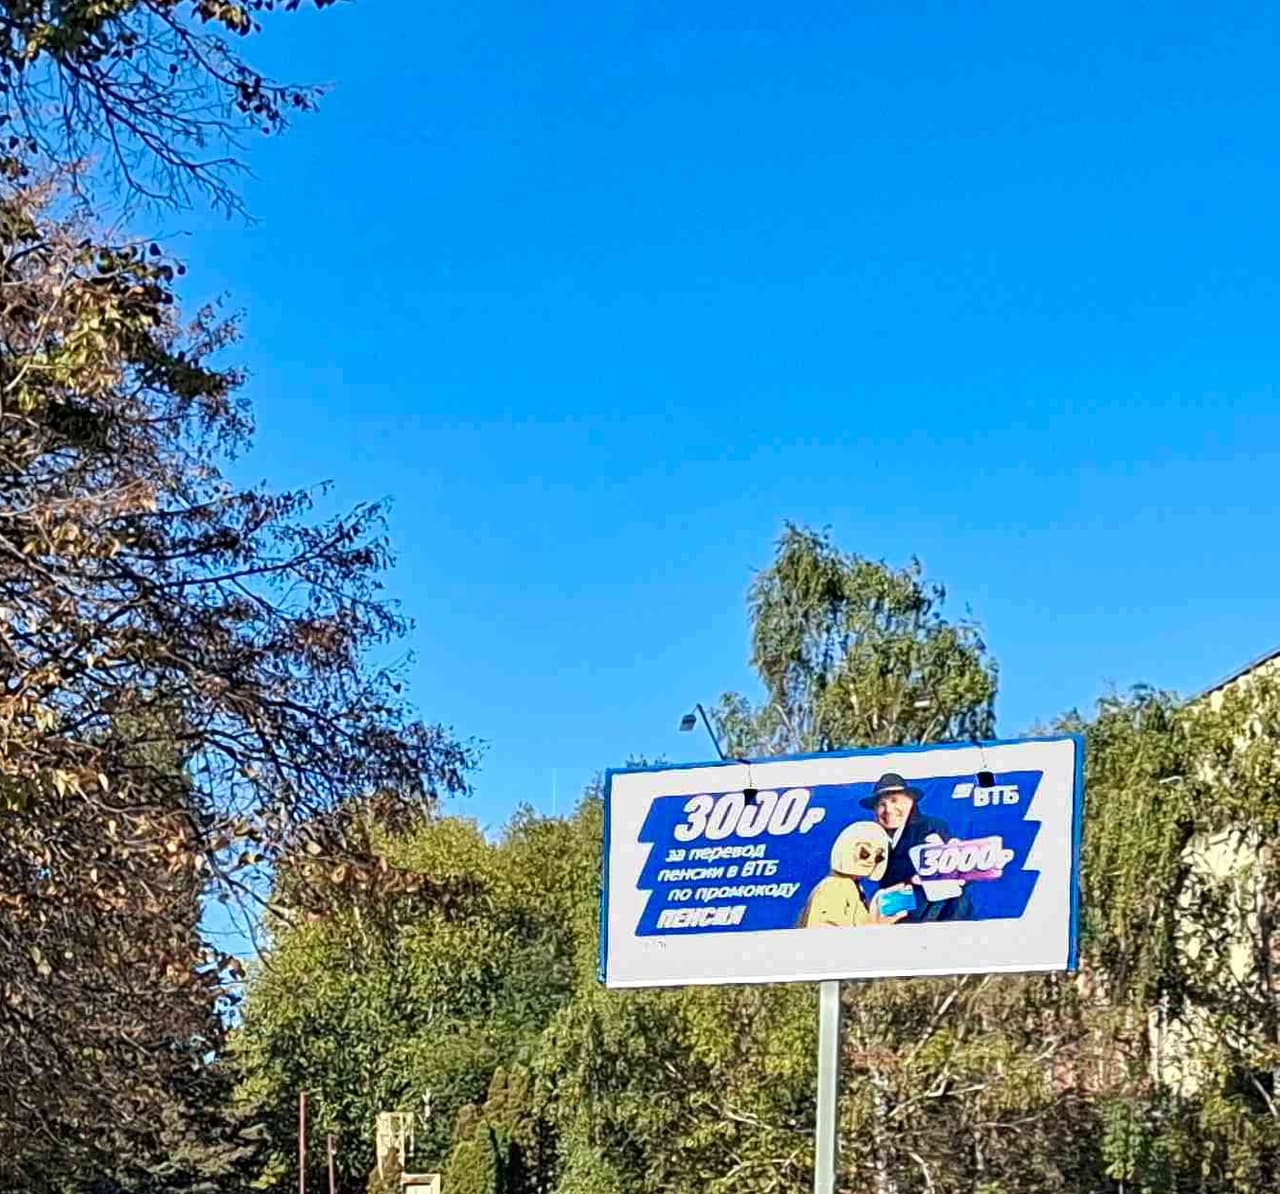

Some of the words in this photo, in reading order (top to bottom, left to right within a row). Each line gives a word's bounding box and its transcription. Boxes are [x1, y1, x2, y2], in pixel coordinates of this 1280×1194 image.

[973, 785, 1019, 807] ВТБ
[665, 849, 686, 862] за
[688, 844, 767, 864] перевод
[657, 865, 724, 882] пенсии
[726, 865, 737, 879] в
[741, 860, 780, 877] ВТБ
[667, 889, 693, 902] по
[694, 882, 800, 903] промокоду
